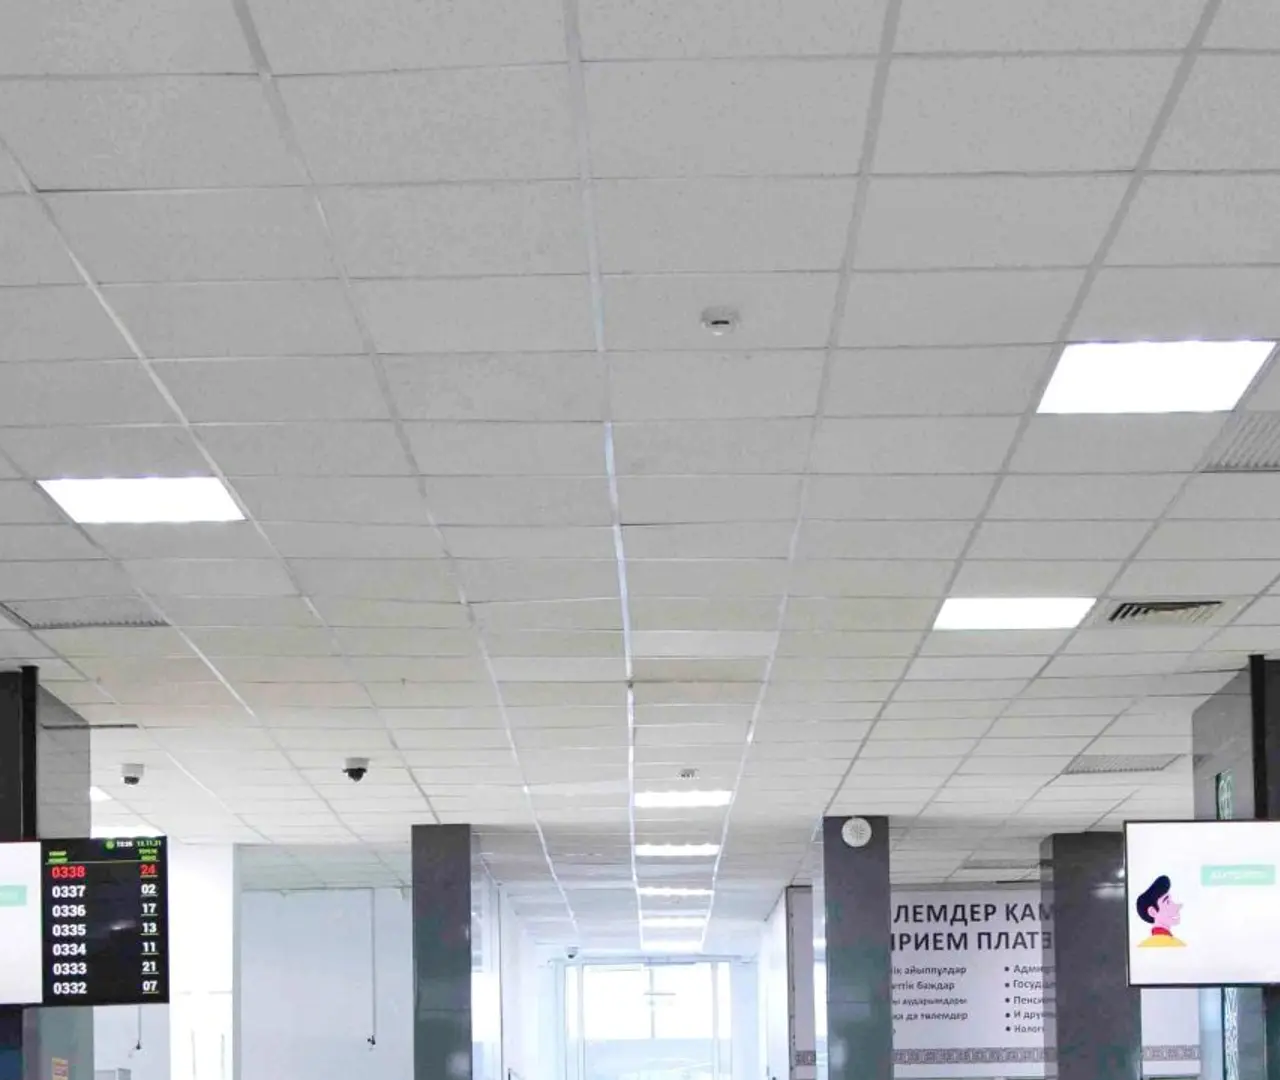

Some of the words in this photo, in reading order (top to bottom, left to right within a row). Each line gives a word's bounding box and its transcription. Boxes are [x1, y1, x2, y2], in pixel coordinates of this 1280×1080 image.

[52, 865, 85, 878] 0338
[141, 864, 156, 874] 24
[52, 885, 86, 898] 0337
[141, 884, 156, 894] 02
[52, 904, 86, 917] 0336
[142, 903, 157, 913] 17
[893, 904, 996, 926] ЛЕМДЕР
[52, 923, 87, 937] 0335
[142, 922, 157, 933] 13
[977, 932, 1052, 950] ПЛАТ
[52, 943, 87, 956] 0334
[142, 942, 156, 952] 11
[53, 962, 87, 975] 0333
[142, 961, 156, 972] 21
[53, 982, 88, 995] 0332
[142, 981, 158, 992] 07
